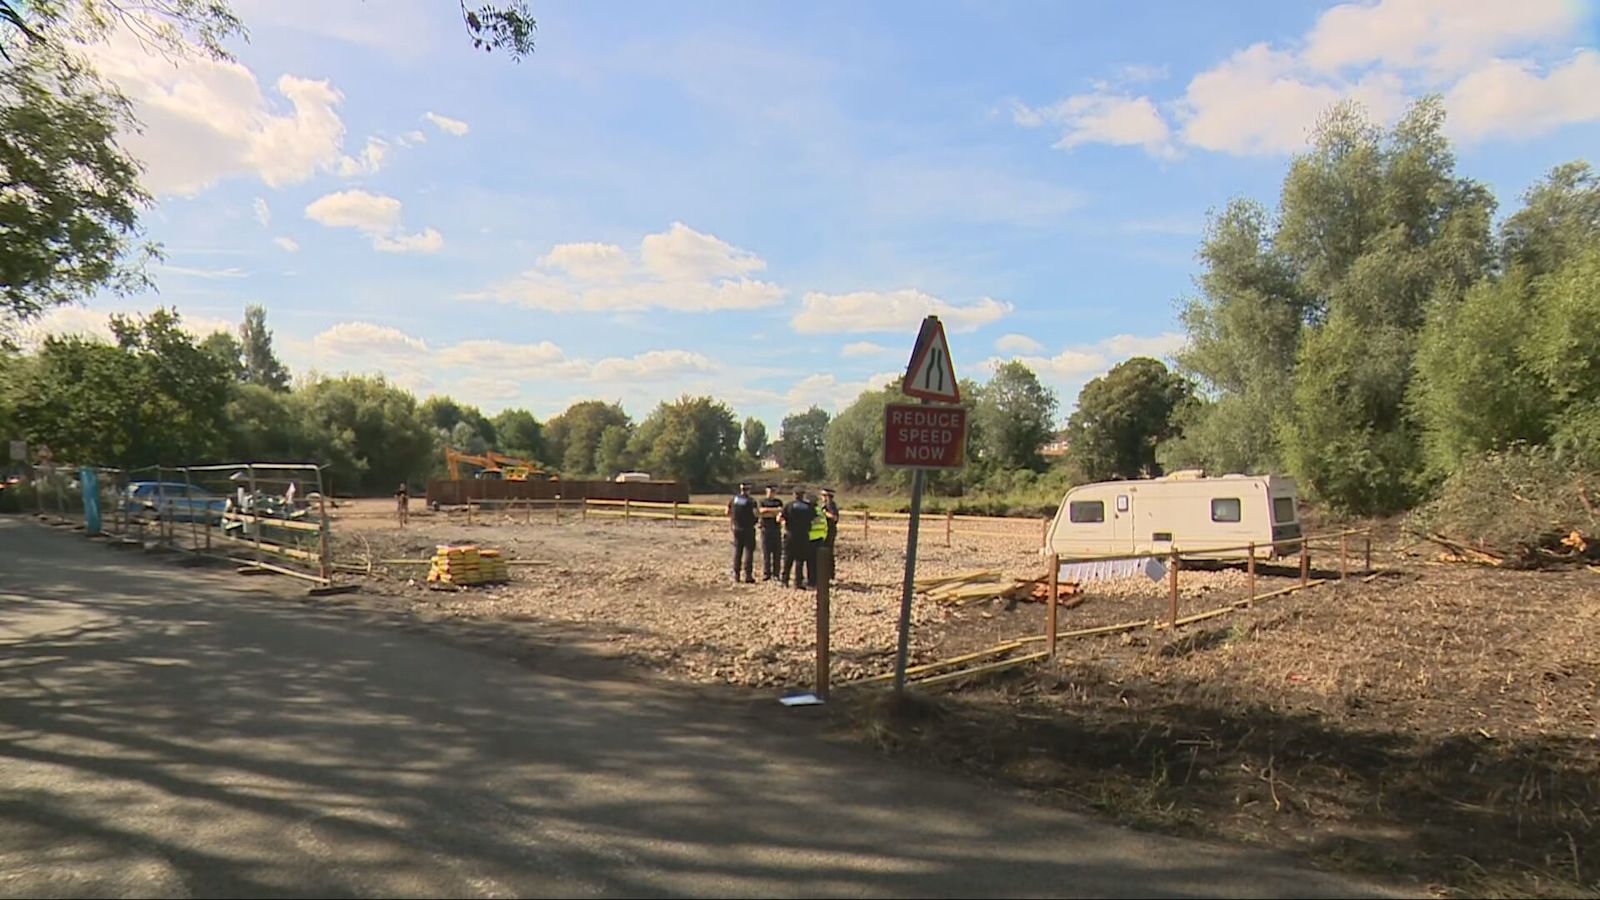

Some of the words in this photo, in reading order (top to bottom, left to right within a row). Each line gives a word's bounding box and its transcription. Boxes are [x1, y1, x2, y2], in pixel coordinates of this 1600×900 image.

[892, 411, 960, 428] REDUCE
[899, 428, 952, 444] SPEED
[905, 446, 945, 460] NOW
